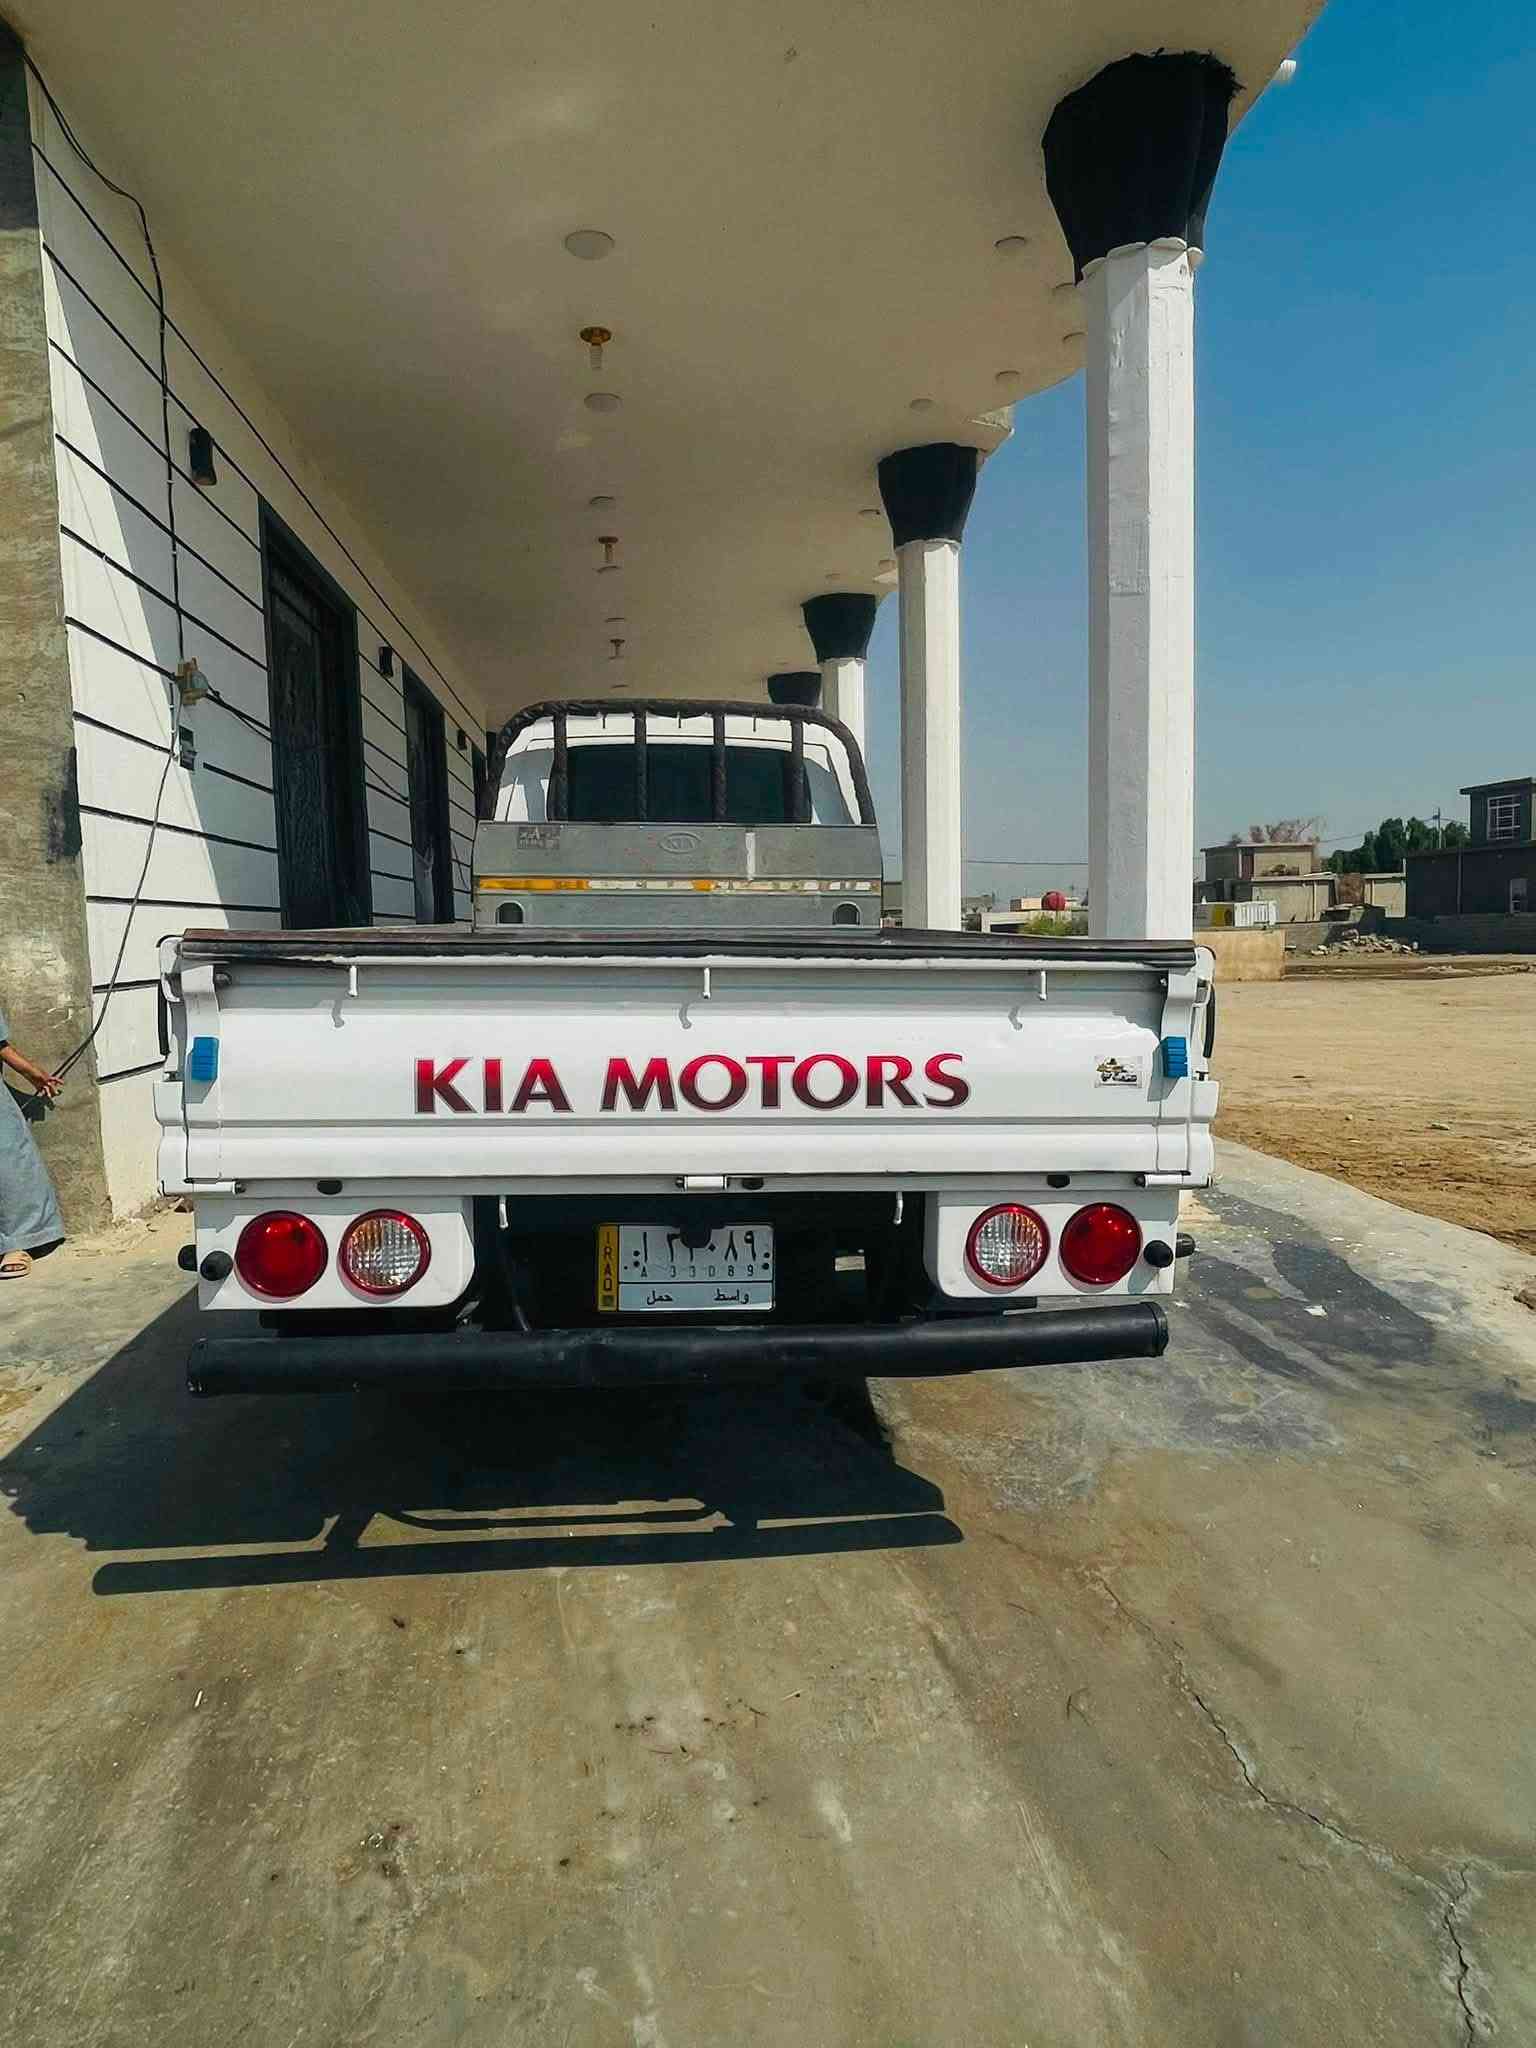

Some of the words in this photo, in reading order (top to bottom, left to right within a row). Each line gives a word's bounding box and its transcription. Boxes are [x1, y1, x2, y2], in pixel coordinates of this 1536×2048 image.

[414, 1057, 576, 1115] KIA
[599, 1053, 971, 1113] MOTORS
[603, 1231, 613, 1291] IRAQ
[646, 1290, 674, 1305] حمل
[713, 1288, 750, 1305] واسط
